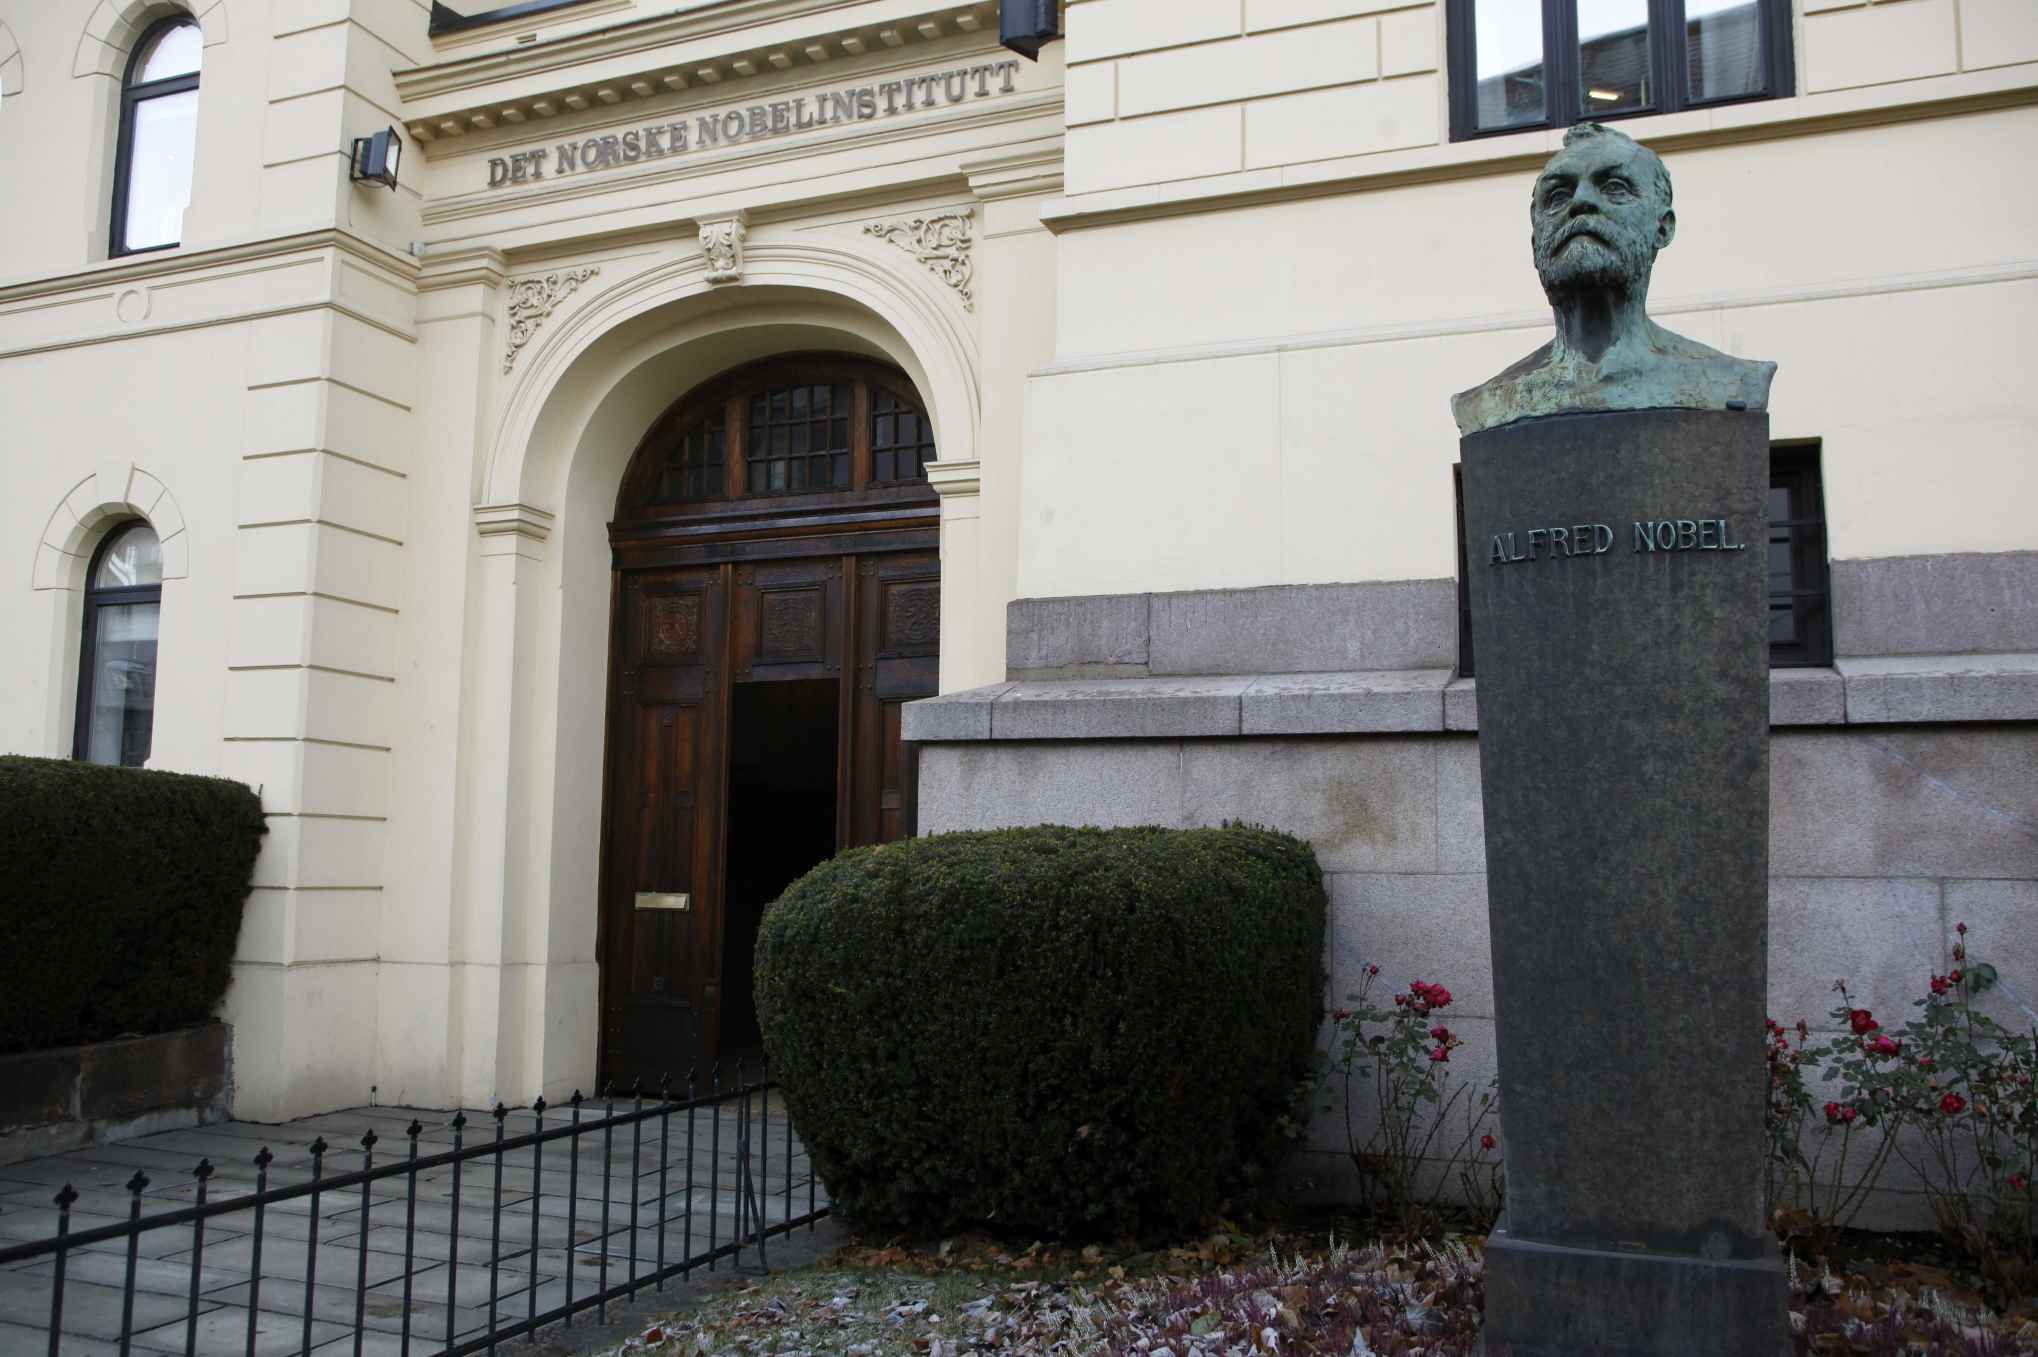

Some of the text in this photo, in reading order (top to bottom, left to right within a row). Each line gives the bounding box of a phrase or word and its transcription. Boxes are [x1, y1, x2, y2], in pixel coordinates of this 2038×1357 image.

[487, 60, 1019, 188] DET NORSKE NOBELINSTITUTT
[1490, 519, 1746, 565] ALFRED NOBEL.
